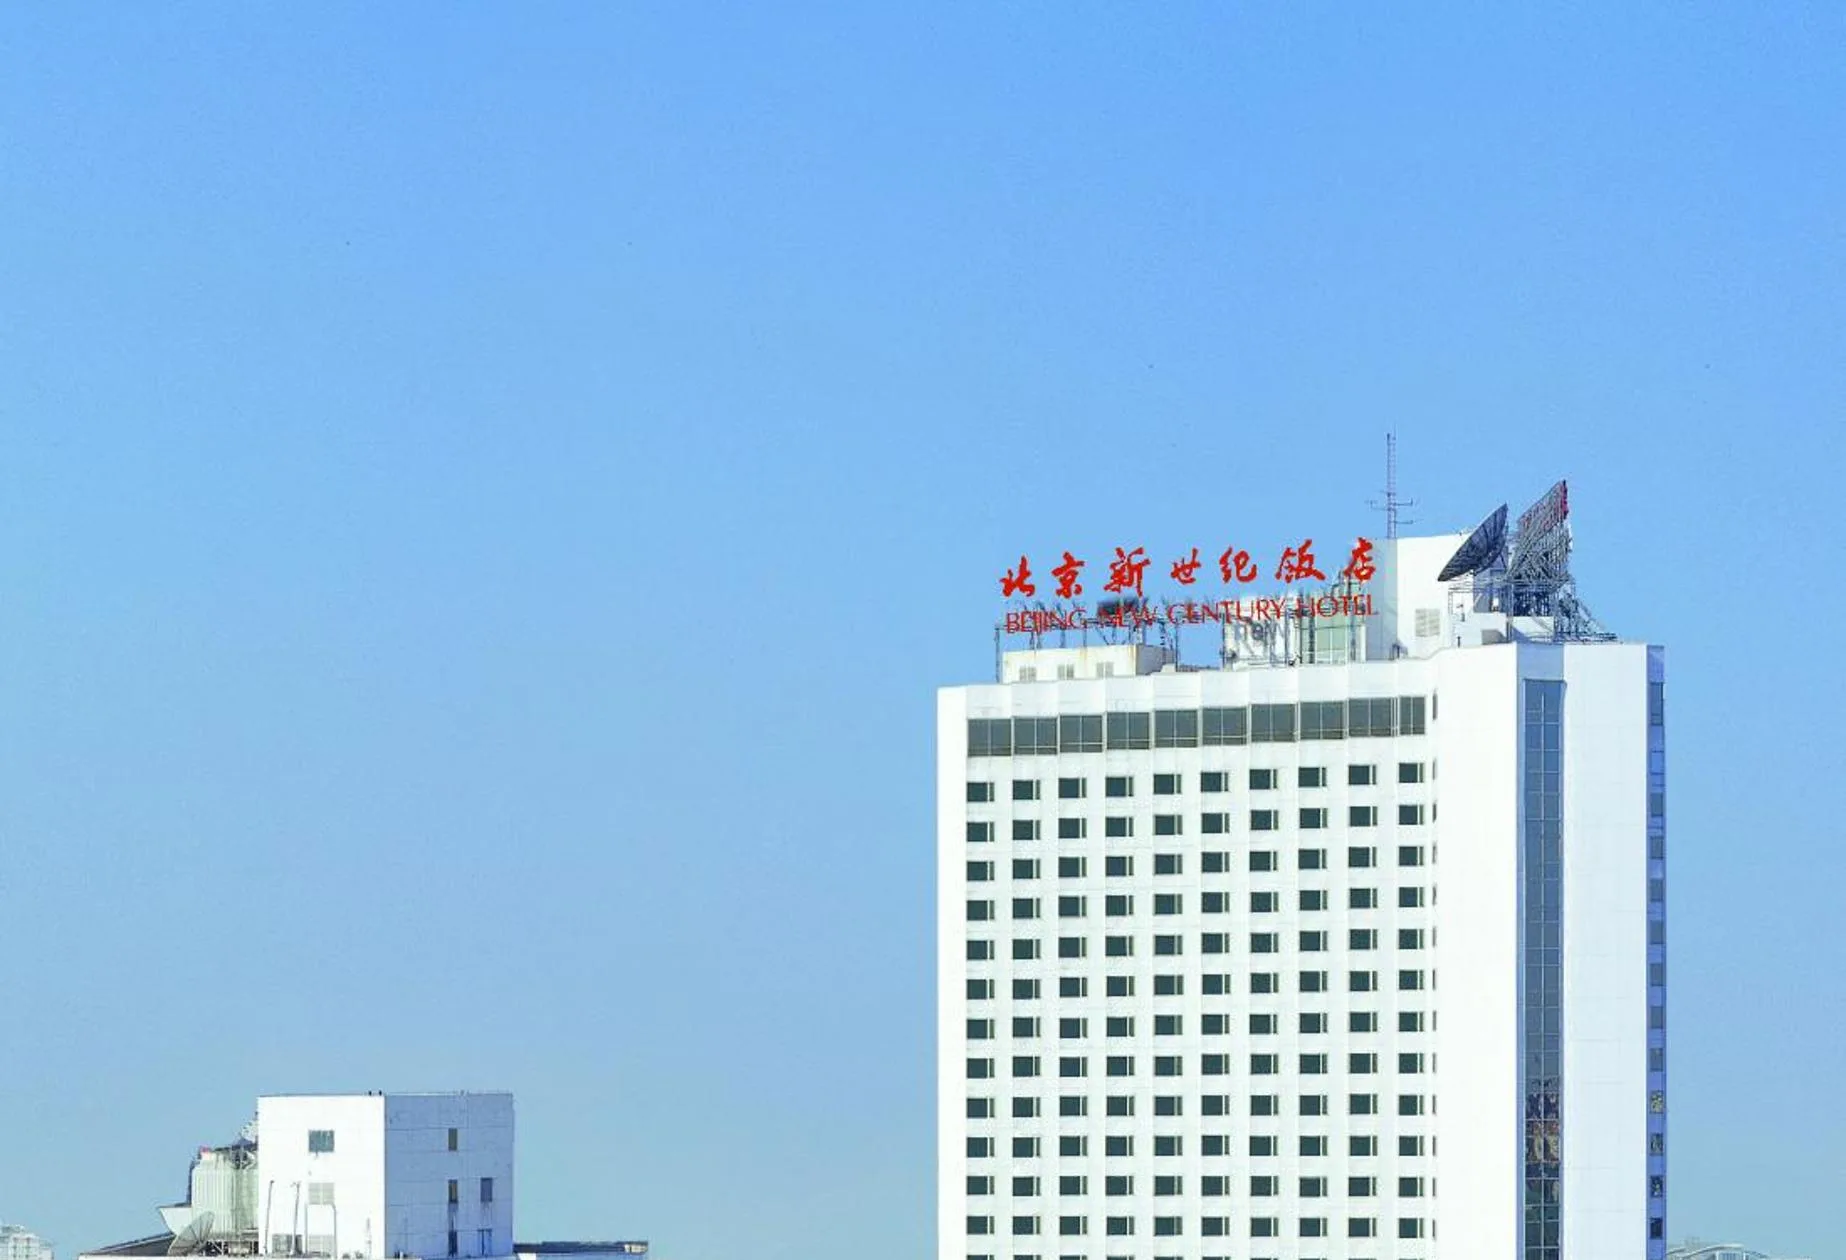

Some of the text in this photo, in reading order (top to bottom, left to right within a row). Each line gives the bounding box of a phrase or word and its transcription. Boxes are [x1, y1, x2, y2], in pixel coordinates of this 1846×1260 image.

[1007, 594, 1378, 634] BEIJING NEW CENTURY HOTEL
